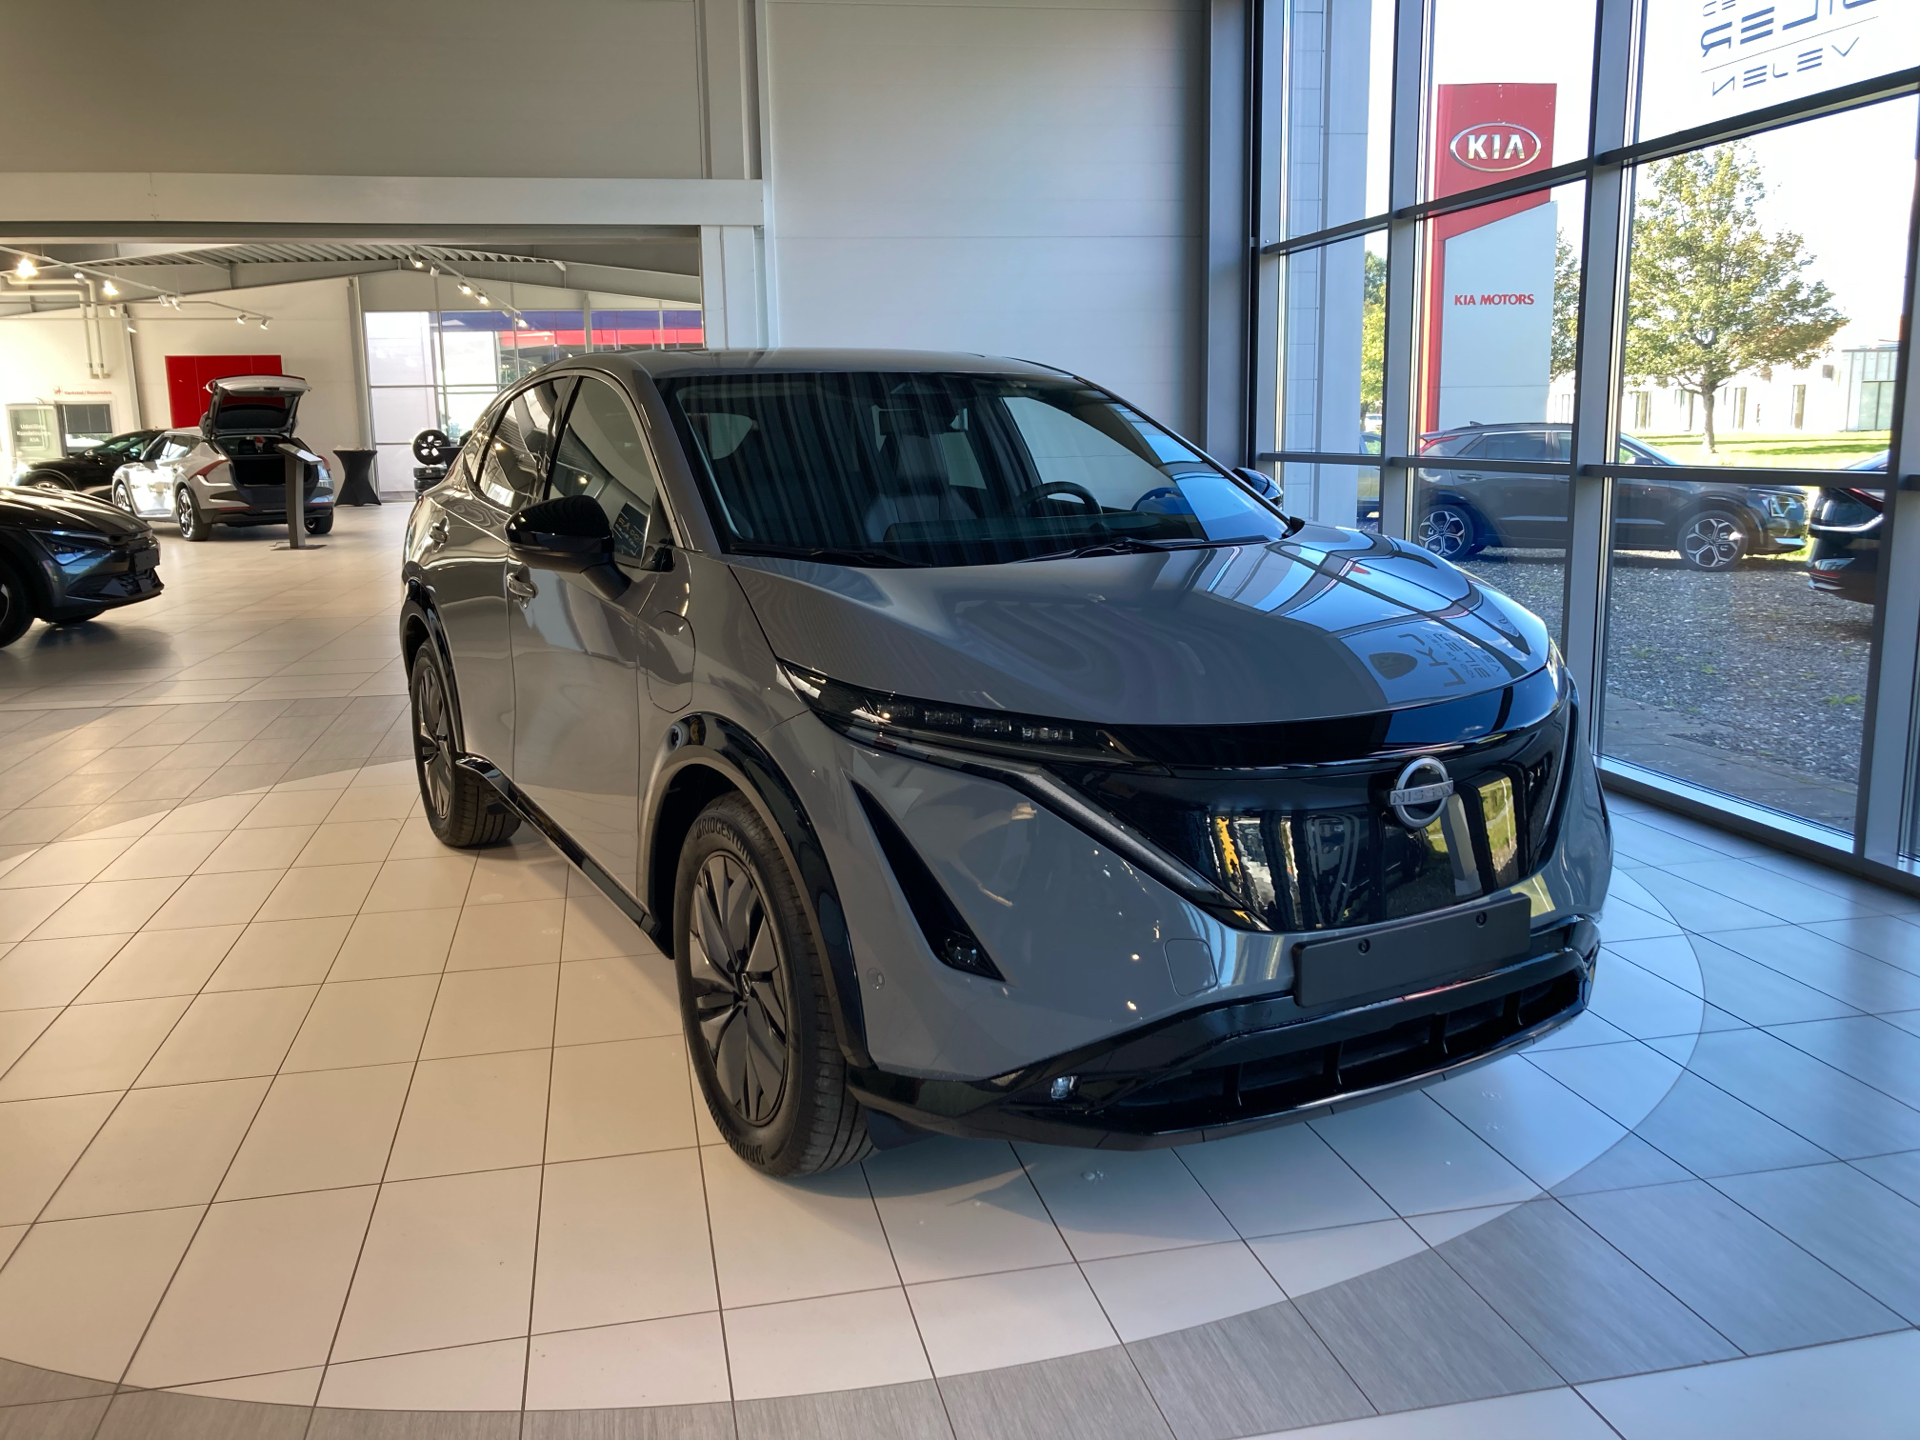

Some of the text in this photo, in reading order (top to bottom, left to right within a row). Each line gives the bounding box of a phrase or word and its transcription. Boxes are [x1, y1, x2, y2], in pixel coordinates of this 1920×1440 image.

[1467, 134, 1526, 160] KIA
[1454, 294, 1535, 306] KIA MOTORS
[1392, 784, 1453, 804] NISSAN
